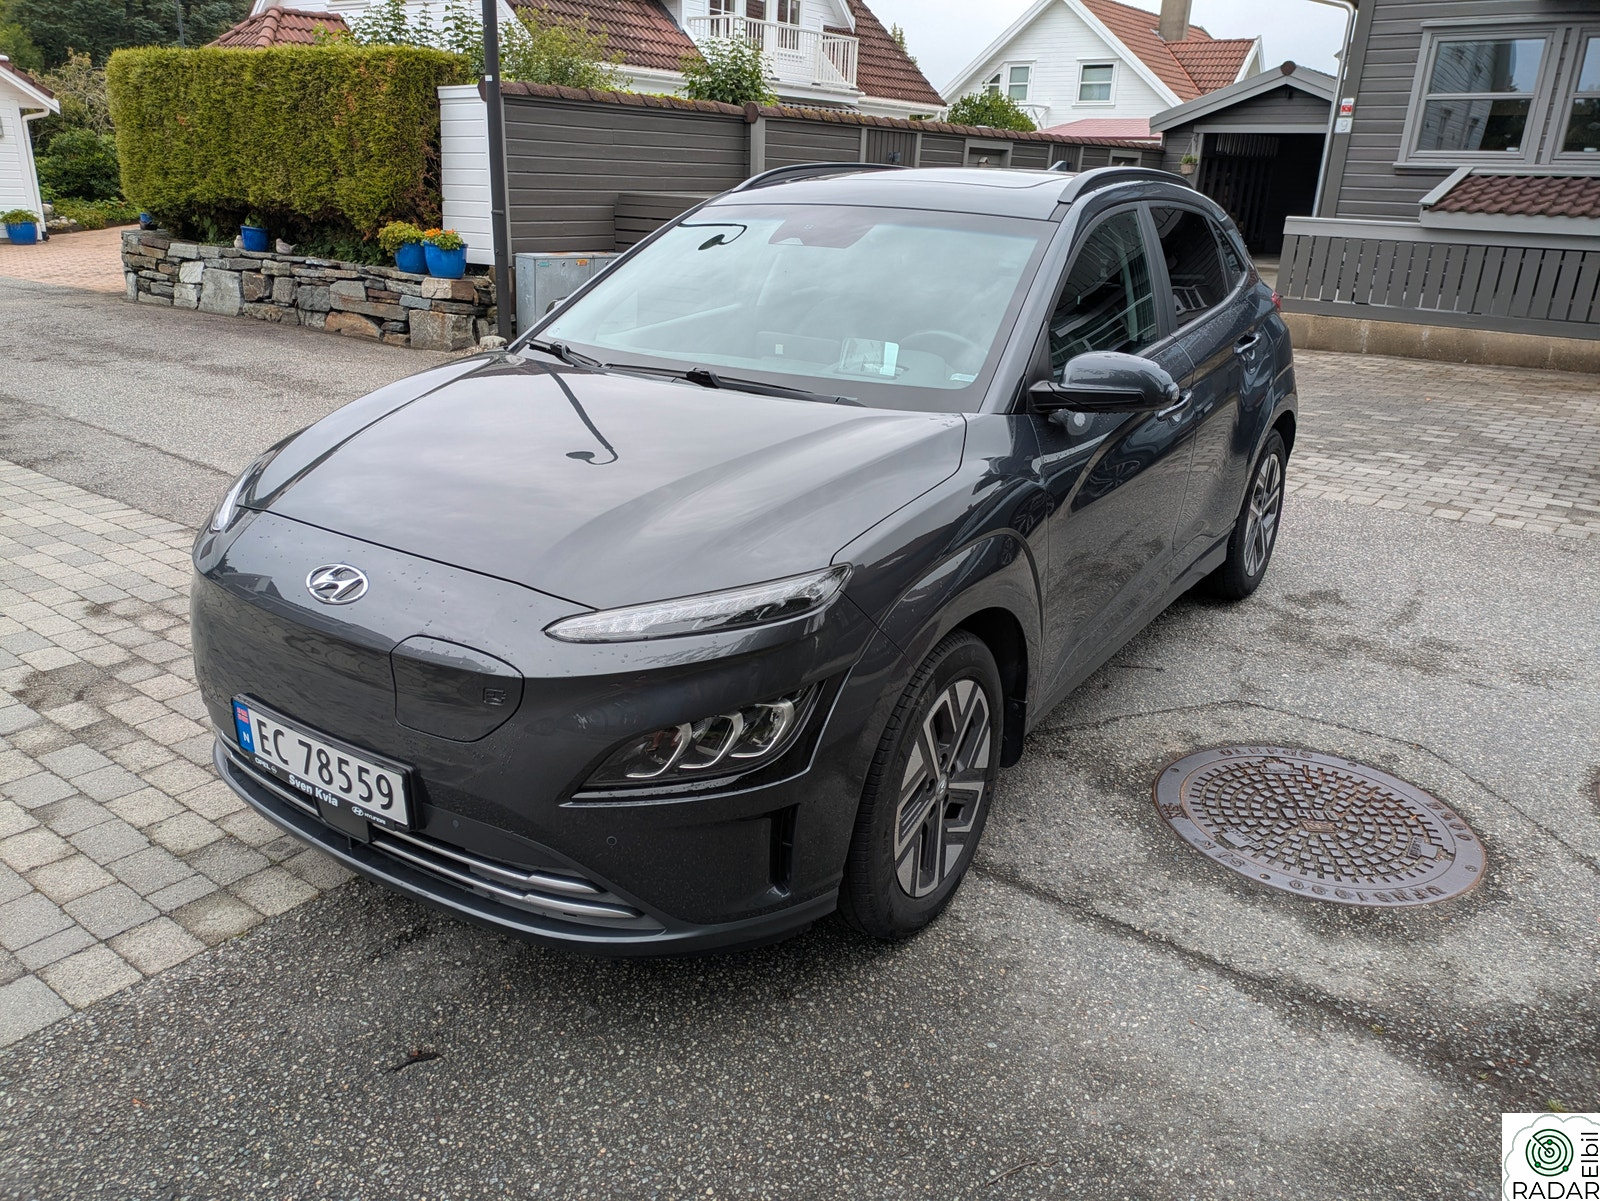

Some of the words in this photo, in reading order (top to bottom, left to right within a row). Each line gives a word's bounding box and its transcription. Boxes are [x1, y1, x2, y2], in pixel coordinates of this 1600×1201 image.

[242, 731, 251, 744] N
[256, 717, 289, 765] EC
[297, 738, 394, 811] 78559
[288, 773, 314, 795] Sven
[315, 789, 339, 808] Kvia
